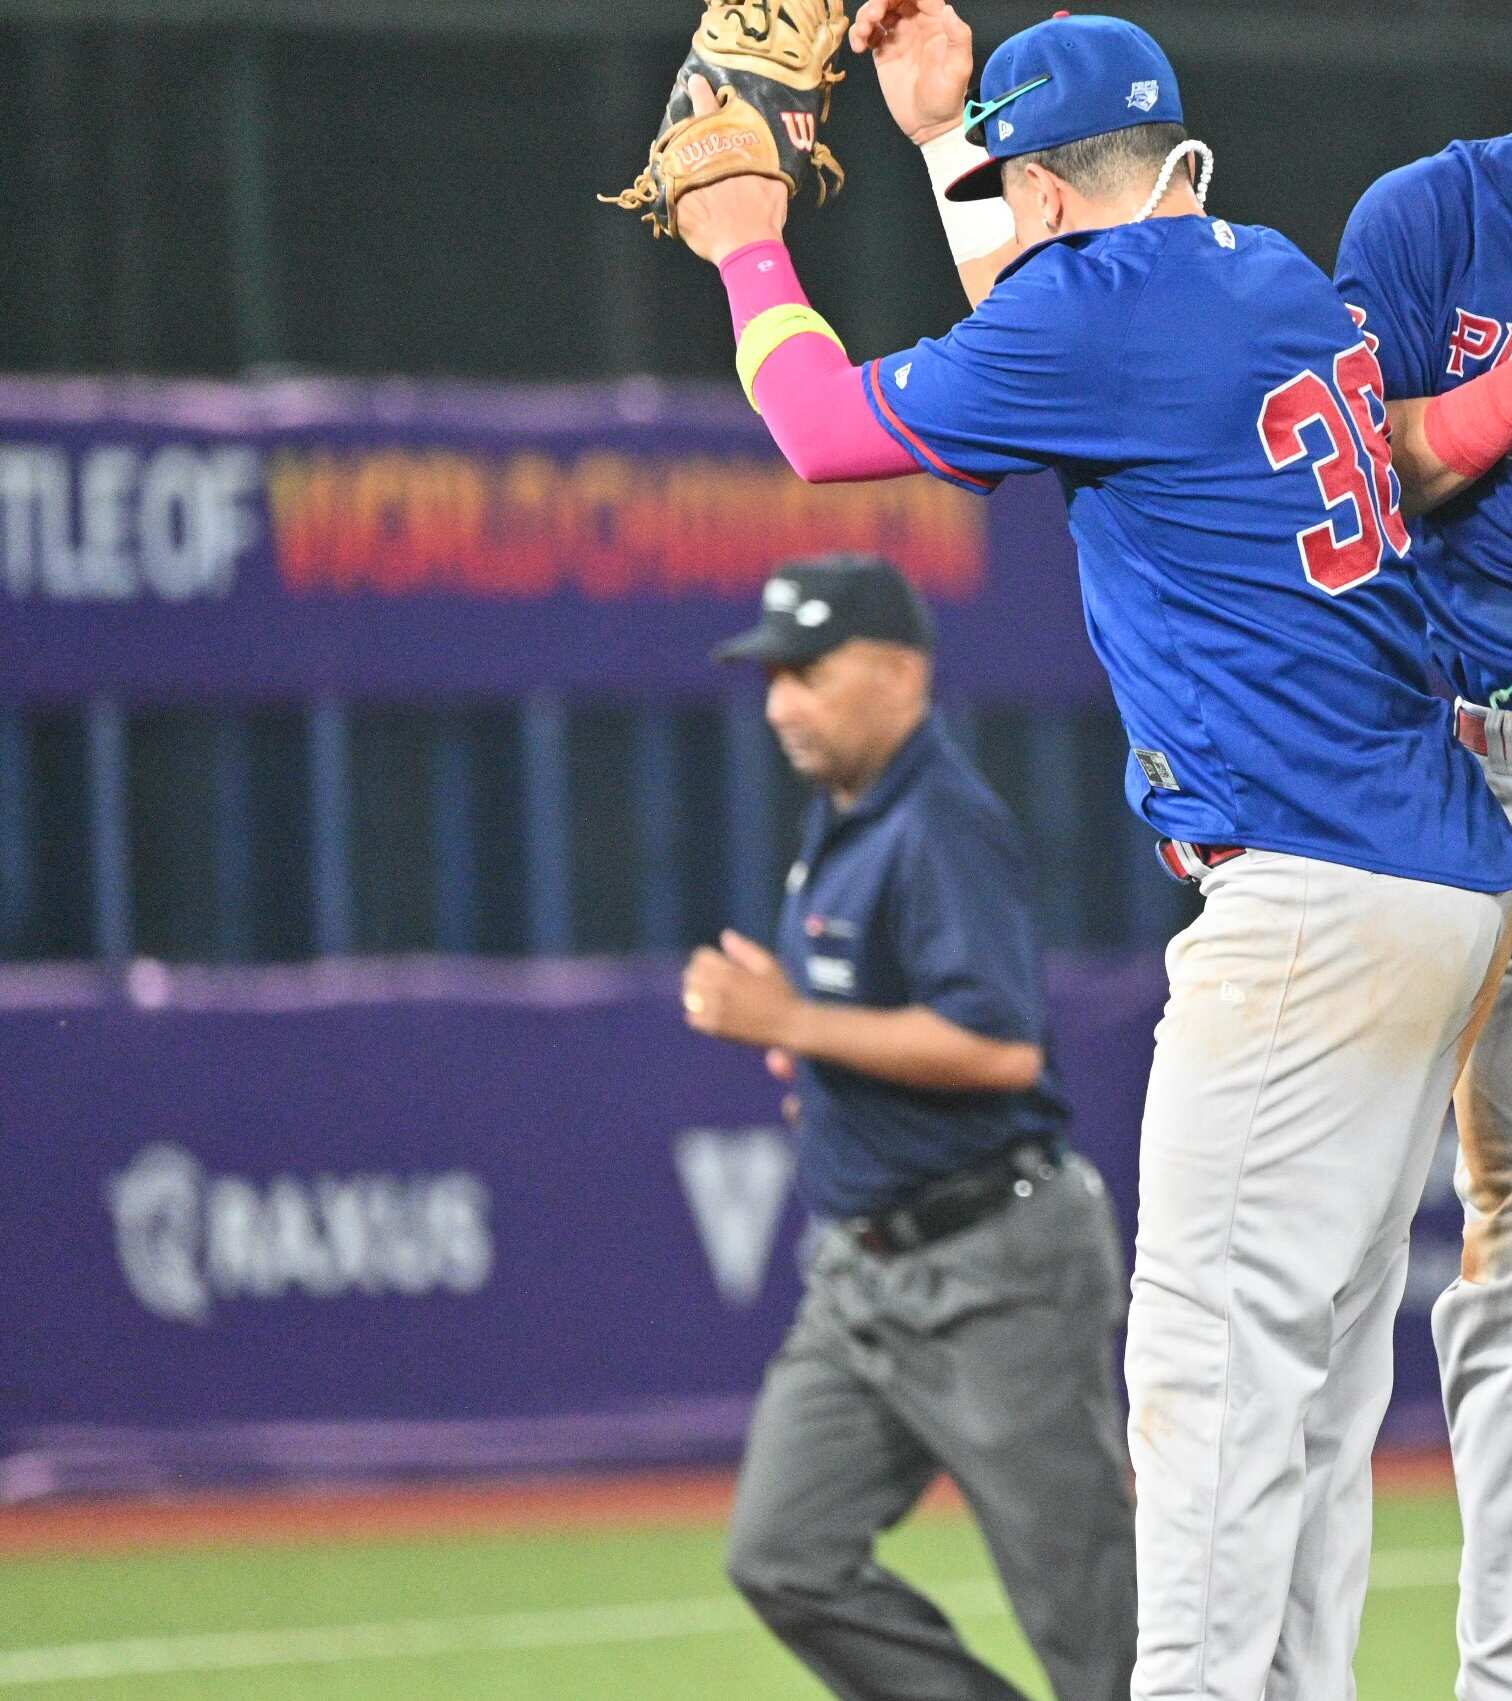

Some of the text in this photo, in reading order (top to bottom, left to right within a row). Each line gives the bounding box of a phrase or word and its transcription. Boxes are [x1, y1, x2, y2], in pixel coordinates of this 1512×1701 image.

[676, 129, 760, 166] Wilson
[779, 111, 817, 152] W
[139, 446, 258, 598] OF
